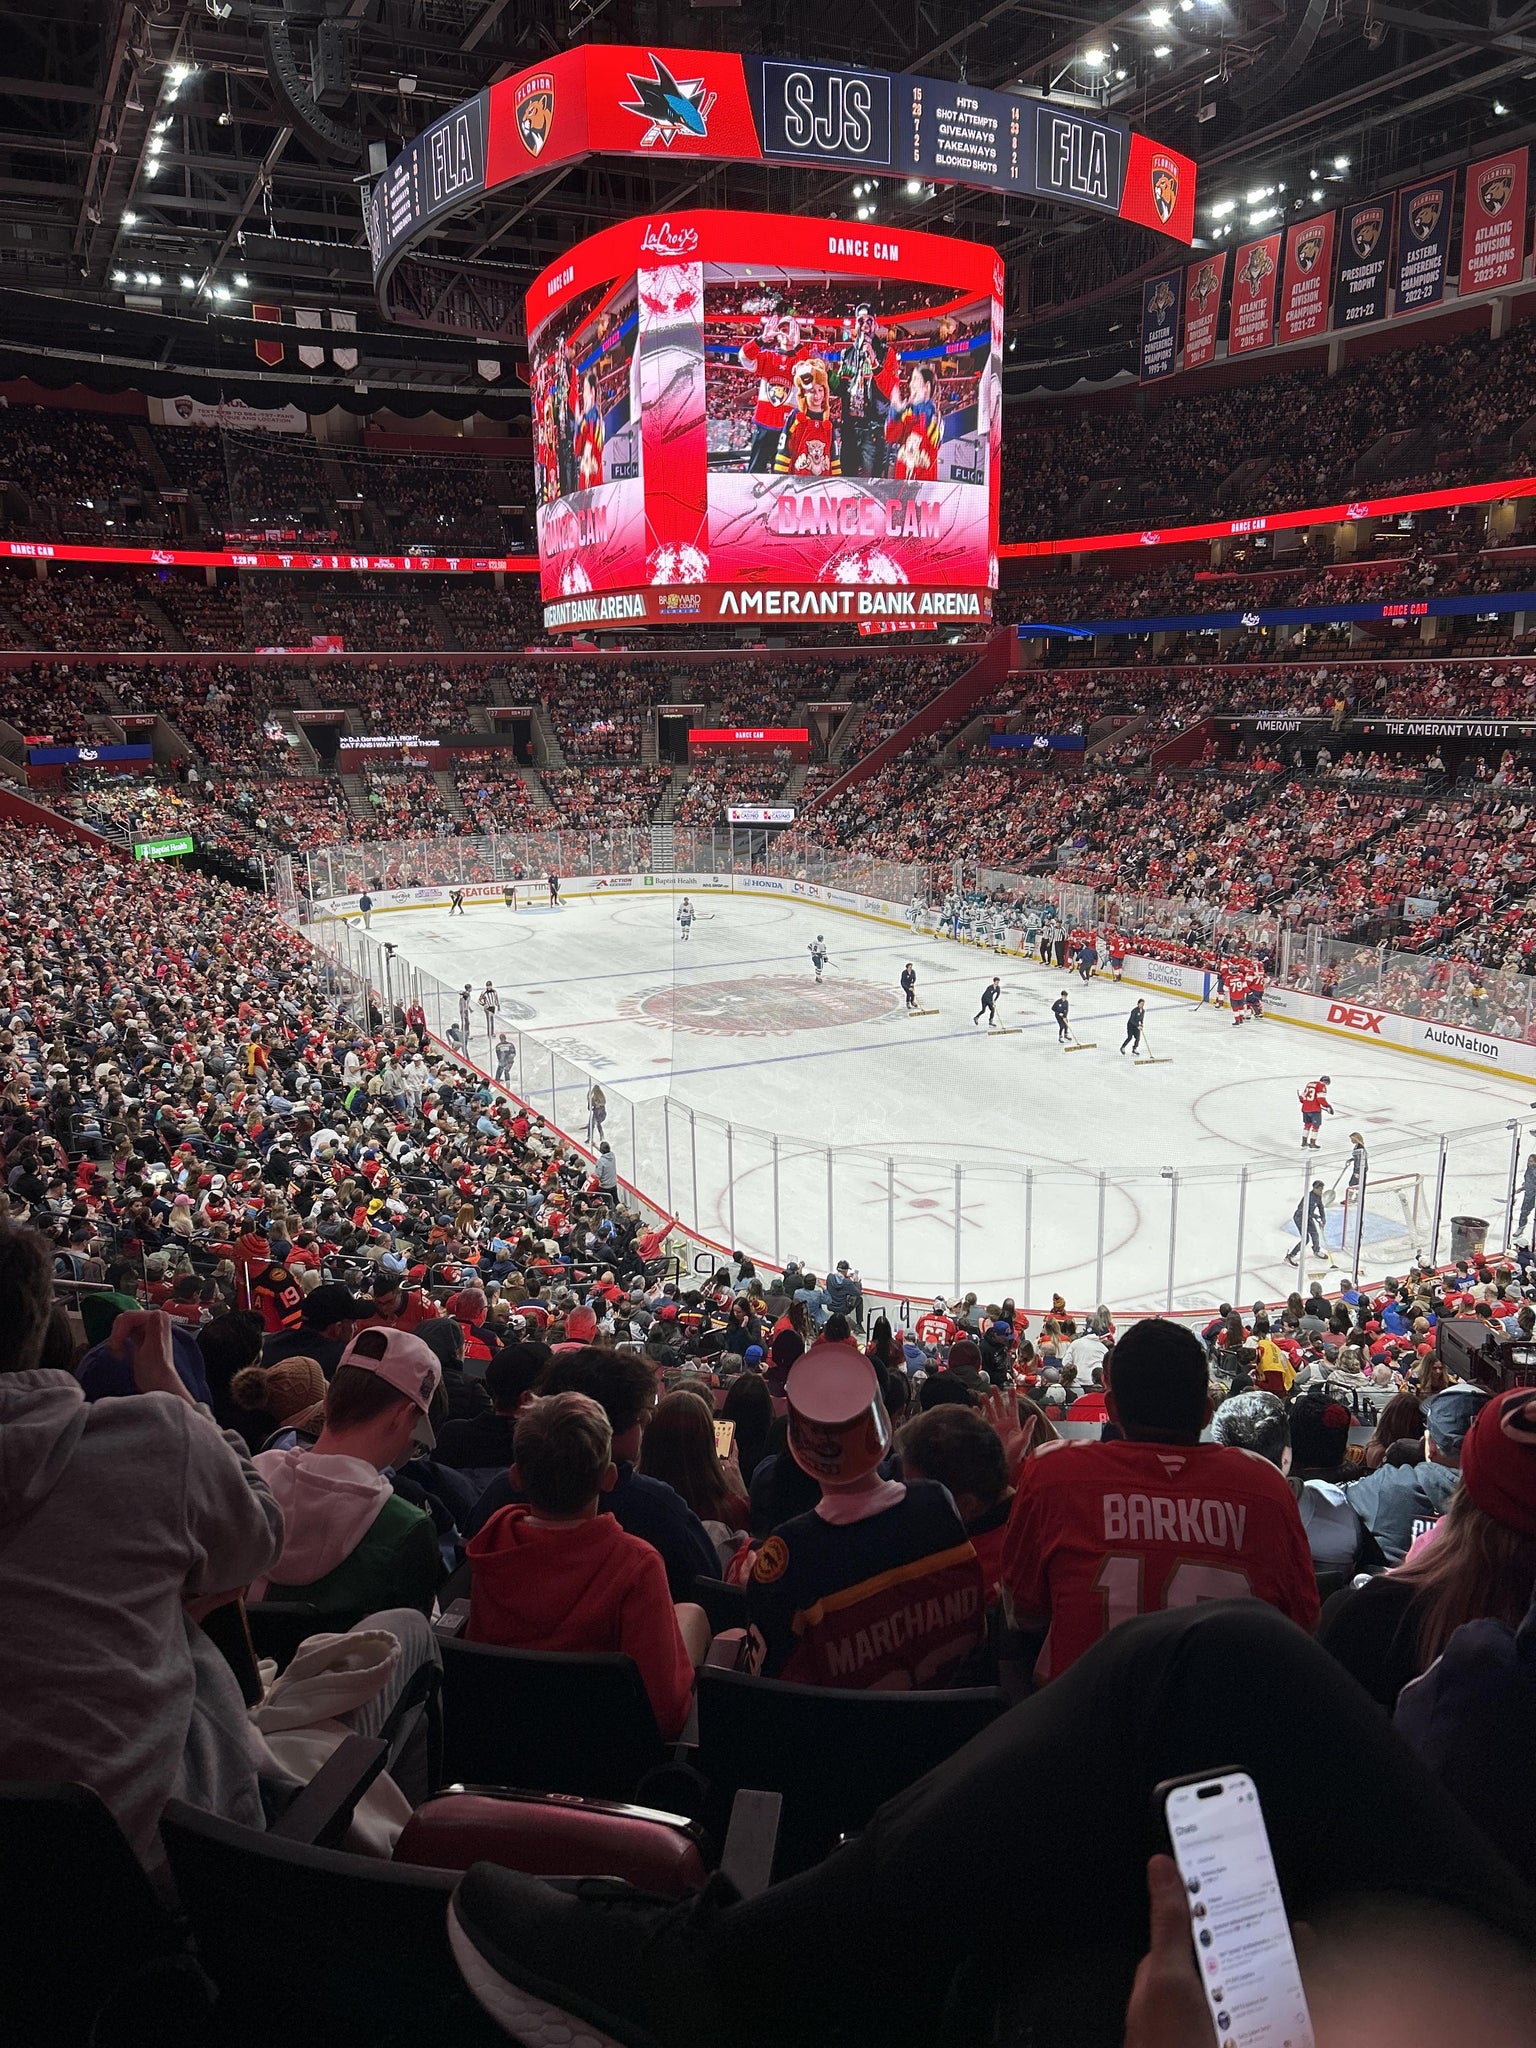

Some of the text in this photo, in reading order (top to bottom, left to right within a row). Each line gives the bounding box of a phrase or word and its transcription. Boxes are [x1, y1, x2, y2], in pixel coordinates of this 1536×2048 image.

[517, 77, 552, 102] FLORIDA
[784, 72, 872, 152] SJS
[956, 96, 979, 111] HITS
[914, 118, 920, 132] 7
[936, 108, 998, 129] SHOT ATTEMPTS
[914, 133, 920, 147] 2
[939, 124, 995, 143] GIVEAWAYS
[431, 114, 474, 201] FLA
[937, 138, 997, 158] TAKEAWAYS
[1011, 151, 1018, 164] 2
[935, 153, 998, 173] BLOCKED SHOTS
[1050, 118, 1109, 199] FLA
[1010, 165, 1019, 179] 11
[641, 222, 699, 252] LaCroix
[1475, 219, 1513, 242] ATLANTIC
[828, 236, 899, 262] DANCE CAM
[1407, 243, 1438, 264] EASTERN
[1475, 234, 1511, 256] DIVISION
[1400, 254, 1443, 279] CONFERENCE
[1468, 247, 1516, 271] CHAMPIONS
[1341, 259, 1386, 282] PRESIDENTS'
[1473, 263, 1508, 284] 2023-24
[547, 272, 563, 297] DANCE
[1291, 276, 1321, 296] ATLANTIC
[1349, 276, 1377, 294] TROPHY
[1400, 269, 1440, 292] CHAMPIONS
[1291, 290, 1319, 309] DIVISION
[1405, 285, 1433, 304] 2022-23
[1238, 297, 1268, 315] ATLANTIC
[1285, 302, 1323, 322] CHAMPIONS
[1345, 302, 1375, 321] 2021-22
[1239, 308, 1266, 325] DIVISION
[1289, 316, 1316, 333] 2021-22
[1148, 326, 1171, 342] EASTERN
[1234, 319, 1269, 337] CHAMPIONS
[1144, 336, 1174, 355] CONFERENCE
[1144, 348, 1172, 365] CHAMPIONS
[1148, 361, 1168, 375] 1995-96
[777, 495, 941, 539] DANCE CAM
[1230, 519, 1266, 533] DANCE CAM
[545, 504, 608, 556] DANCE CAM
[10, 544, 55, 557] DANCE CAM
[247, 556, 258, 565] PM
[282, 559, 291, 568] 17
[332, 556, 338, 569] 3
[350, 557, 369, 569] 6:19
[404, 558, 411, 569] 0
[571, 593, 645, 622] BANK ARENA
[718, 590, 981, 615] AMERANT BANK ARENA
[1382, 603, 1428, 618] DANCE CAM
[735, 730, 765, 739] DANCE CAM
[1256, 720, 1301, 732] AMERANT
[1385, 723, 1509, 737] THE AMERANT VAULT
[151, 841, 188, 855] Baptist Health
[655, 877, 698, 885] Baptist Health
[751, 880, 784, 890] HONDA
[1118, 941, 1126, 951] 2
[1147, 962, 1183, 978] COMCAST
[1147, 971, 1183, 988] BUSINESS
[1229, 981, 1243, 993] 79
[1326, 1004, 1386, 1034] DEX
[1424, 1027, 1499, 1058] AutoNation
[254, 1295, 262, 1309] A
[279, 1286, 300, 1309] 19
[1103, 1493, 1247, 1551] BARKOV
[825, 1585, 979, 1677] MARCHAND
